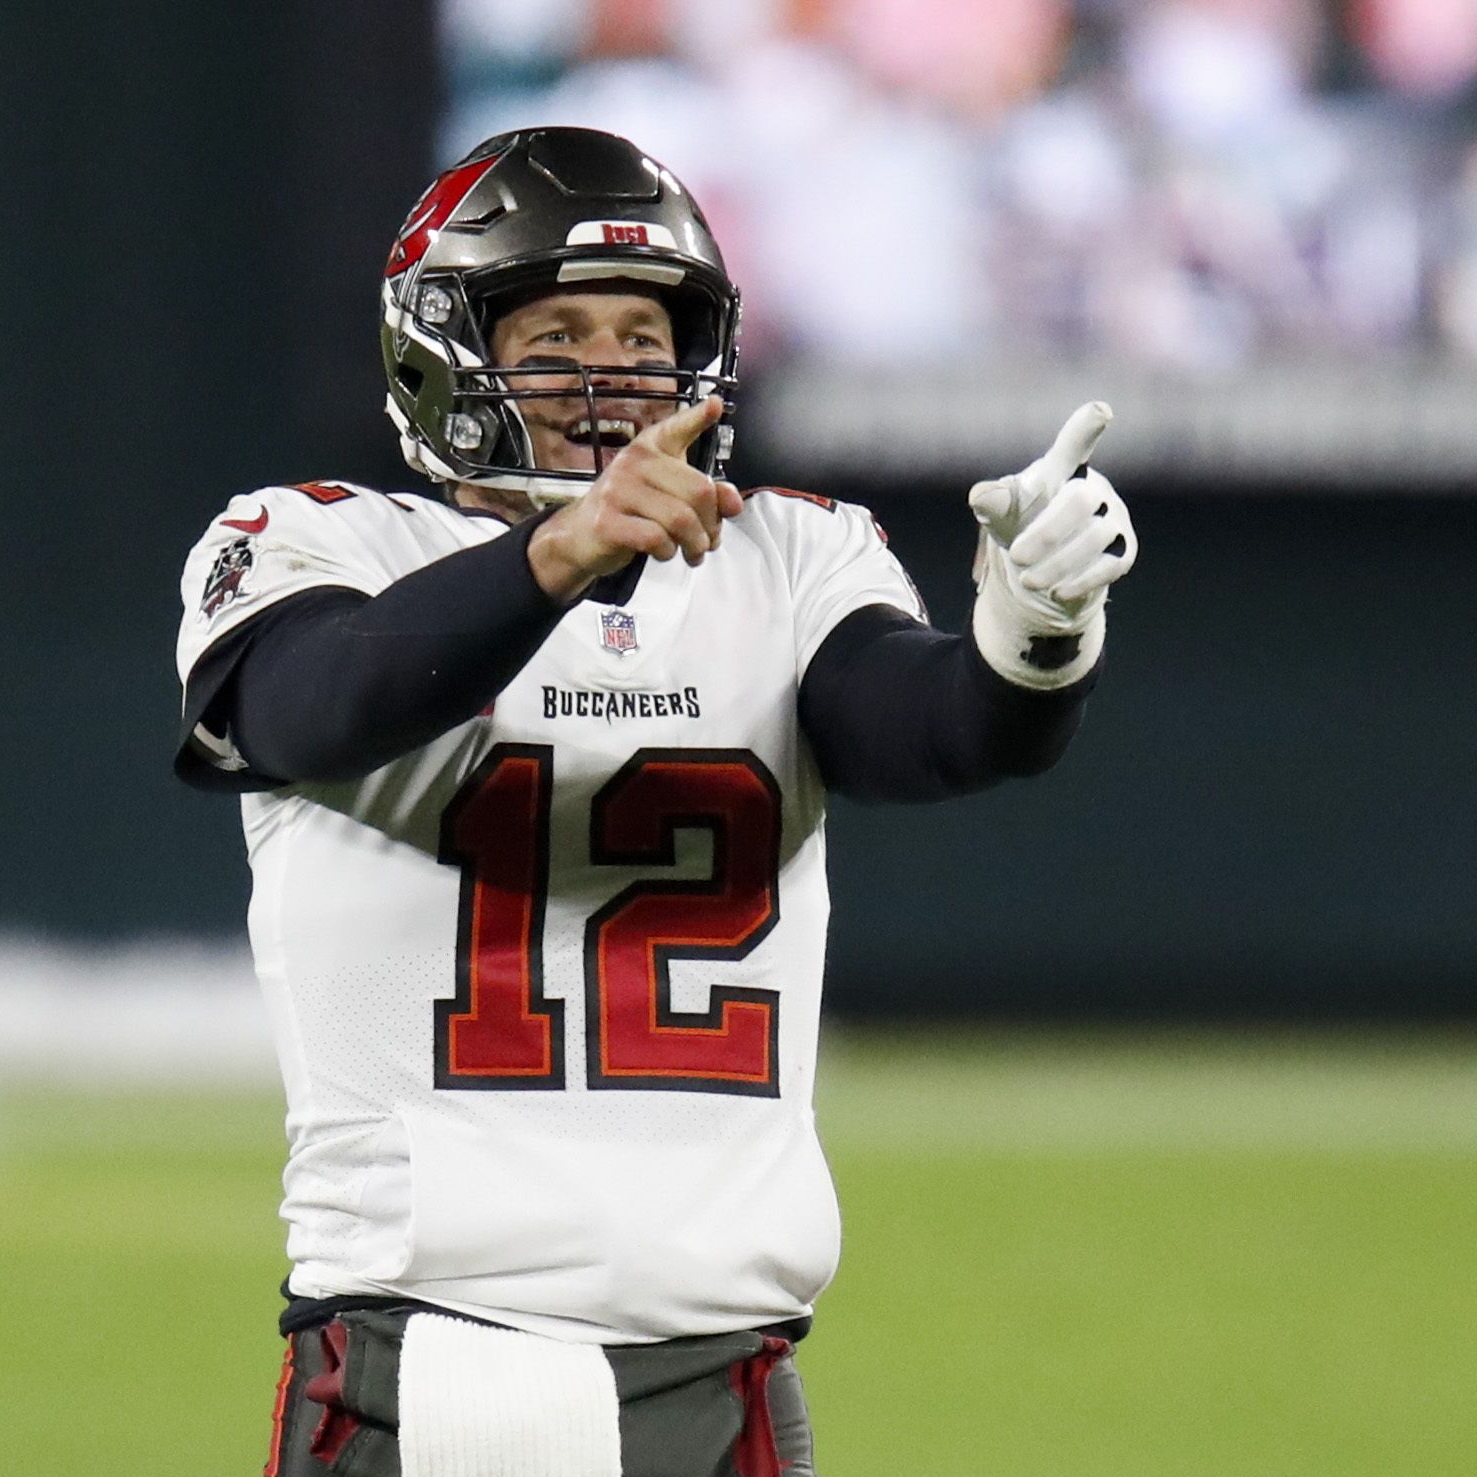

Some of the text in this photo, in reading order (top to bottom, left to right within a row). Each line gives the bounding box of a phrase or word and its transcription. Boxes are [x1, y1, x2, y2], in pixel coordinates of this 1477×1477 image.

[606, 628, 636, 648] NFL
[541, 685, 701, 725] BUCCANEERS
[433, 742, 782, 1099] 12
